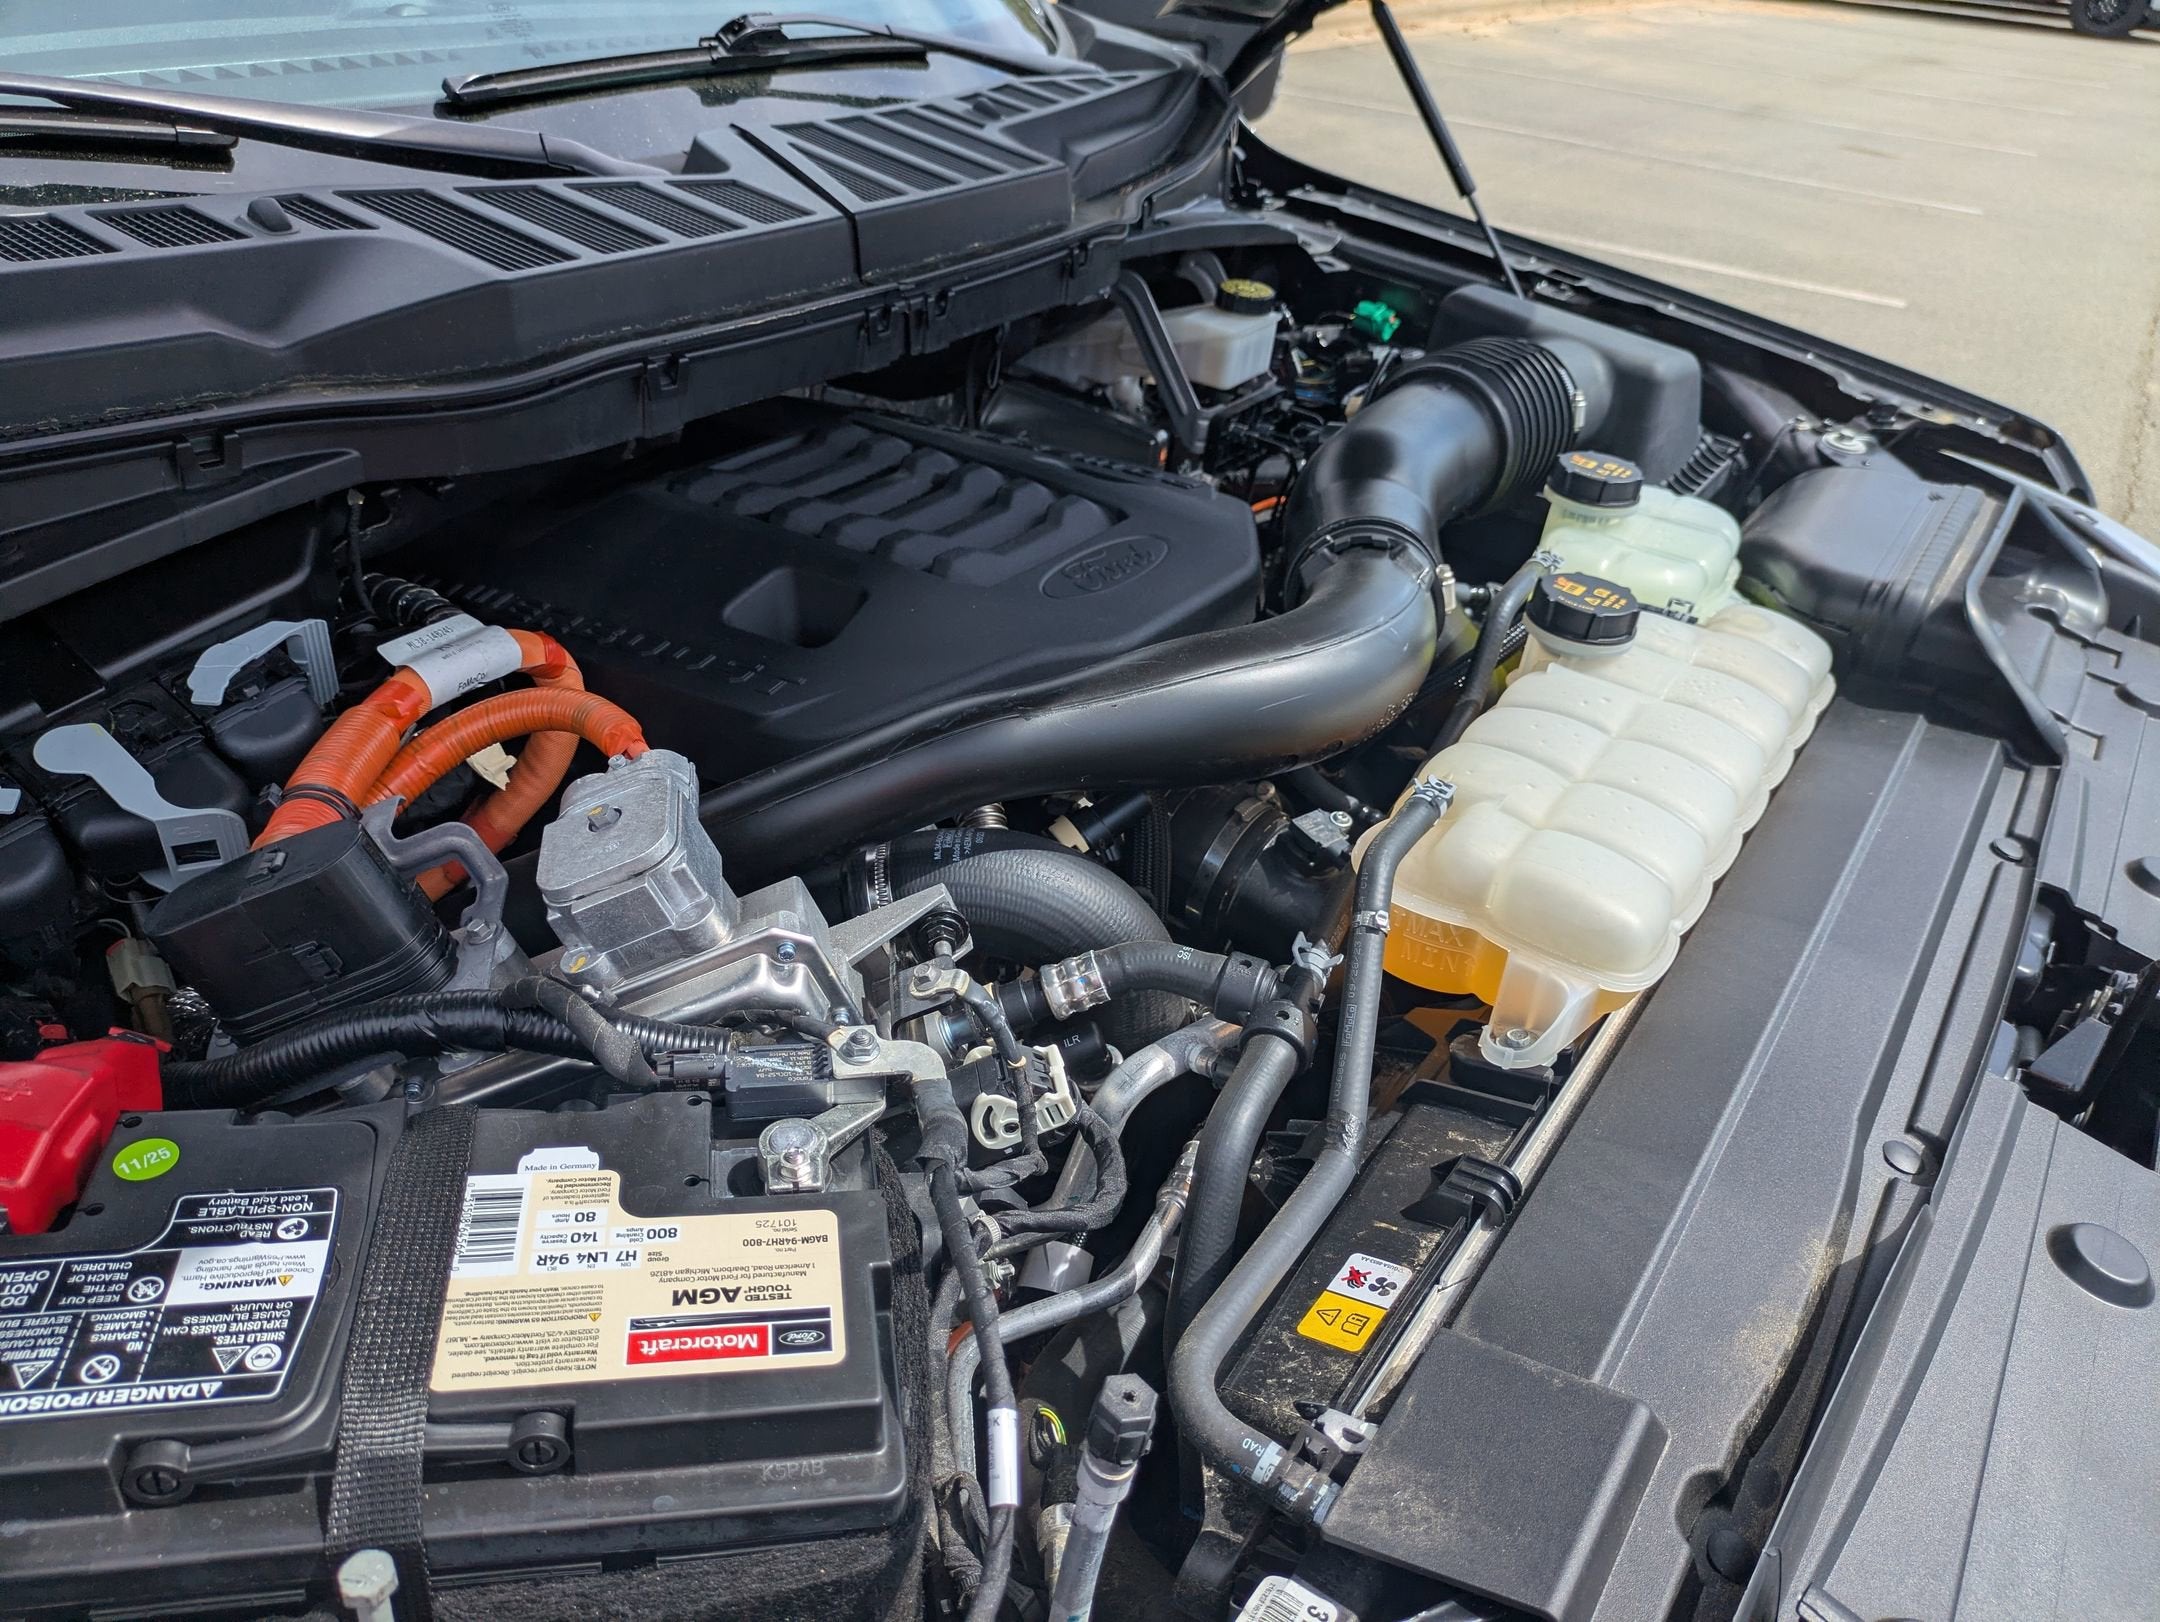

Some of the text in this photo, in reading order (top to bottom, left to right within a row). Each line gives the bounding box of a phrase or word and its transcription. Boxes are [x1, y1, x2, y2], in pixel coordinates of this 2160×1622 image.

[1061, 544, 1155, 591] Ford
[1404, 914, 1466, 947] MAX
[1176, 949, 1191, 959] ISC
[1400, 940, 1458, 973] MIN
[1341, 1003, 1357, 1046] FoMoCo
[1063, 1034, 1080, 1047] ILR
[119, 1147, 171, 1174] 11/25
[559, 1161, 596, 1170] Germany
[208, 1194, 308, 1205] Lead Acid Battery
[197, 1201, 313, 1216] NON-SPILLABLE
[574, 1210, 596, 1222] 80
[187, 1222, 273, 1233] INSTRUCTIONS.
[755, 1218, 796, 1228] 101725
[238, 1230, 270, 1238] READ
[539, 1232, 567, 1240] Capacity
[570, 1231, 597, 1243] 140
[615, 1231, 643, 1239] Cranking
[646, 1227, 677, 1239] 800
[742, 1233, 827, 1247] BAGM-94RH7-800
[536, 1249, 637, 1265] H7 LN4 94R
[69, 1260, 132, 1272] CHILDREN.
[193, 1264, 232, 1273] handling.
[675, 1266, 709, 1275] Michigan
[711, 1265, 749, 1273] Dearborn,
[66, 1271, 128, 1282] REACH OF
[208, 1268, 264, 1280] Reproductive
[658, 1275, 694, 1284] Company
[753, 1269, 806, 1279] Manufactured
[0, 1282, 38, 1296] NOT
[82, 1282, 124, 1293] OF THE
[198, 1277, 276, 1291] WARNING:
[0, 1295, 28, 1307] DO
[58, 1293, 120, 1304] KEEP OUT
[671, 1286, 742, 1306] AGM
[744, 1292, 791, 1301] TESTED
[230, 1300, 293, 1311] OR INJURY.
[22, 1314, 72, 1326] SEVERE
[90, 1310, 147, 1321] SMOKING
[182, 1309, 290, 1324] CAUSE BLINDNESS
[495, 1317, 529, 1325] WARNING:
[540, 1313, 587, 1321] PROPOSITION
[93, 1320, 143, 1331] FLAMES
[162, 1318, 288, 1335] EXPLOSIVE GASES CAN
[89, 1330, 139, 1341] SPARKS
[211, 1330, 285, 1344] SHIELD EYES.
[561, 1334, 598, 1342] distributor
[0, 1336, 63, 1348] CAN CAUS
[125, 1340, 143, 1351] NO
[553, 1341, 585, 1349] complete
[640, 1330, 816, 1355] Ford Motorcraft
[0, 1346, 59, 1360] SULFURIC
[563, 1348, 597, 1356] Warranty
[513, 1358, 553, 1367] protection.
[554, 1356, 585, 1364] warranty
[451, 1370, 481, 1378] required
[483, 1368, 509, 1376] Receipt
[1240, 1436, 1265, 1457] RAD
